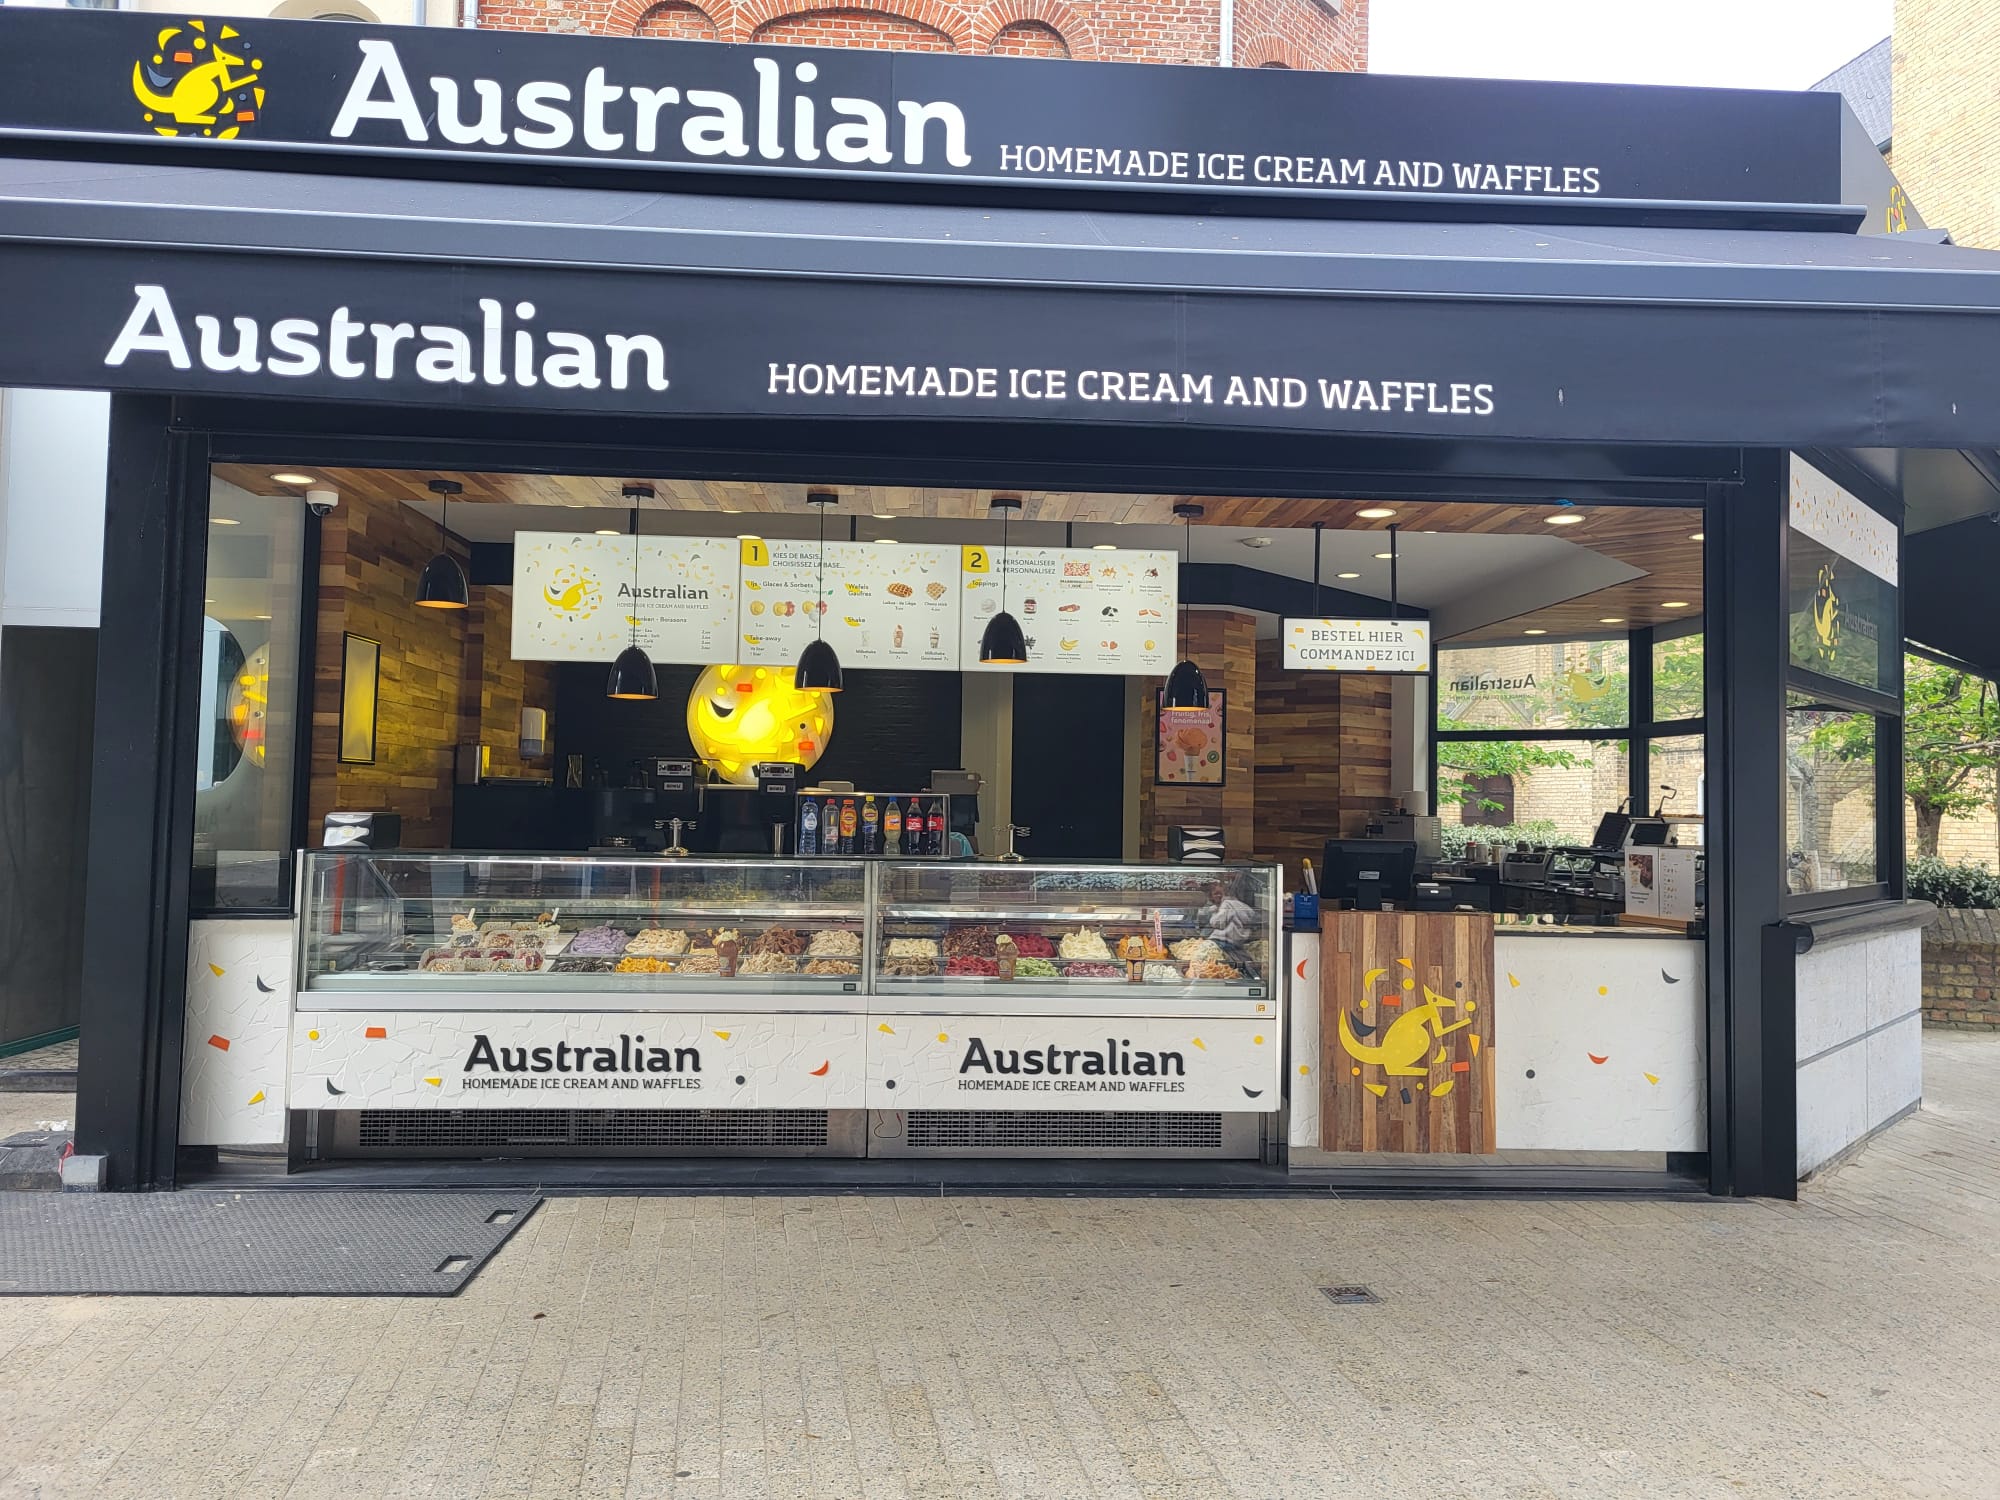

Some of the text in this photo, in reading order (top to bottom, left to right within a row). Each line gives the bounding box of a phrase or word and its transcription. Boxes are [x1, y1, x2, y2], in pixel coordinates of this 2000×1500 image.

[330, 39, 971, 168] Australian
[999, 144, 1601, 194] HOMEMADE ICE CREAM AND WAFFLES
[104, 283, 670, 391] Australian
[767, 362, 1495, 416] HOMEMADE ICE CREAM AND WAFFLES
[752, 545, 758, 561] 1
[970, 552, 982, 568] 2
[772, 560, 812, 568] CHOISISSEZ
[1003, 559, 1056, 567] PERSONALISEER
[1003, 567, 1057, 575] PERSONNALISEZ
[617, 582, 709, 600] Australian
[790, 581, 814, 589] Sorbets
[972, 580, 999, 588] Toppings
[750, 634, 782, 642] Take-away
[1311, 630, 1404, 643] BESTEL HIER
[1300, 648, 1415, 662] COMMANDEZ ICI
[463, 1034, 702, 1073] Australian
[959, 1037, 1186, 1076] Australian
[462, 1078, 701, 1089] HOMEMADE ICE CREAM AND WAFFLES
[957, 1080, 1185, 1093] HOMEMADE ICE CREAM AND WAFFLES
